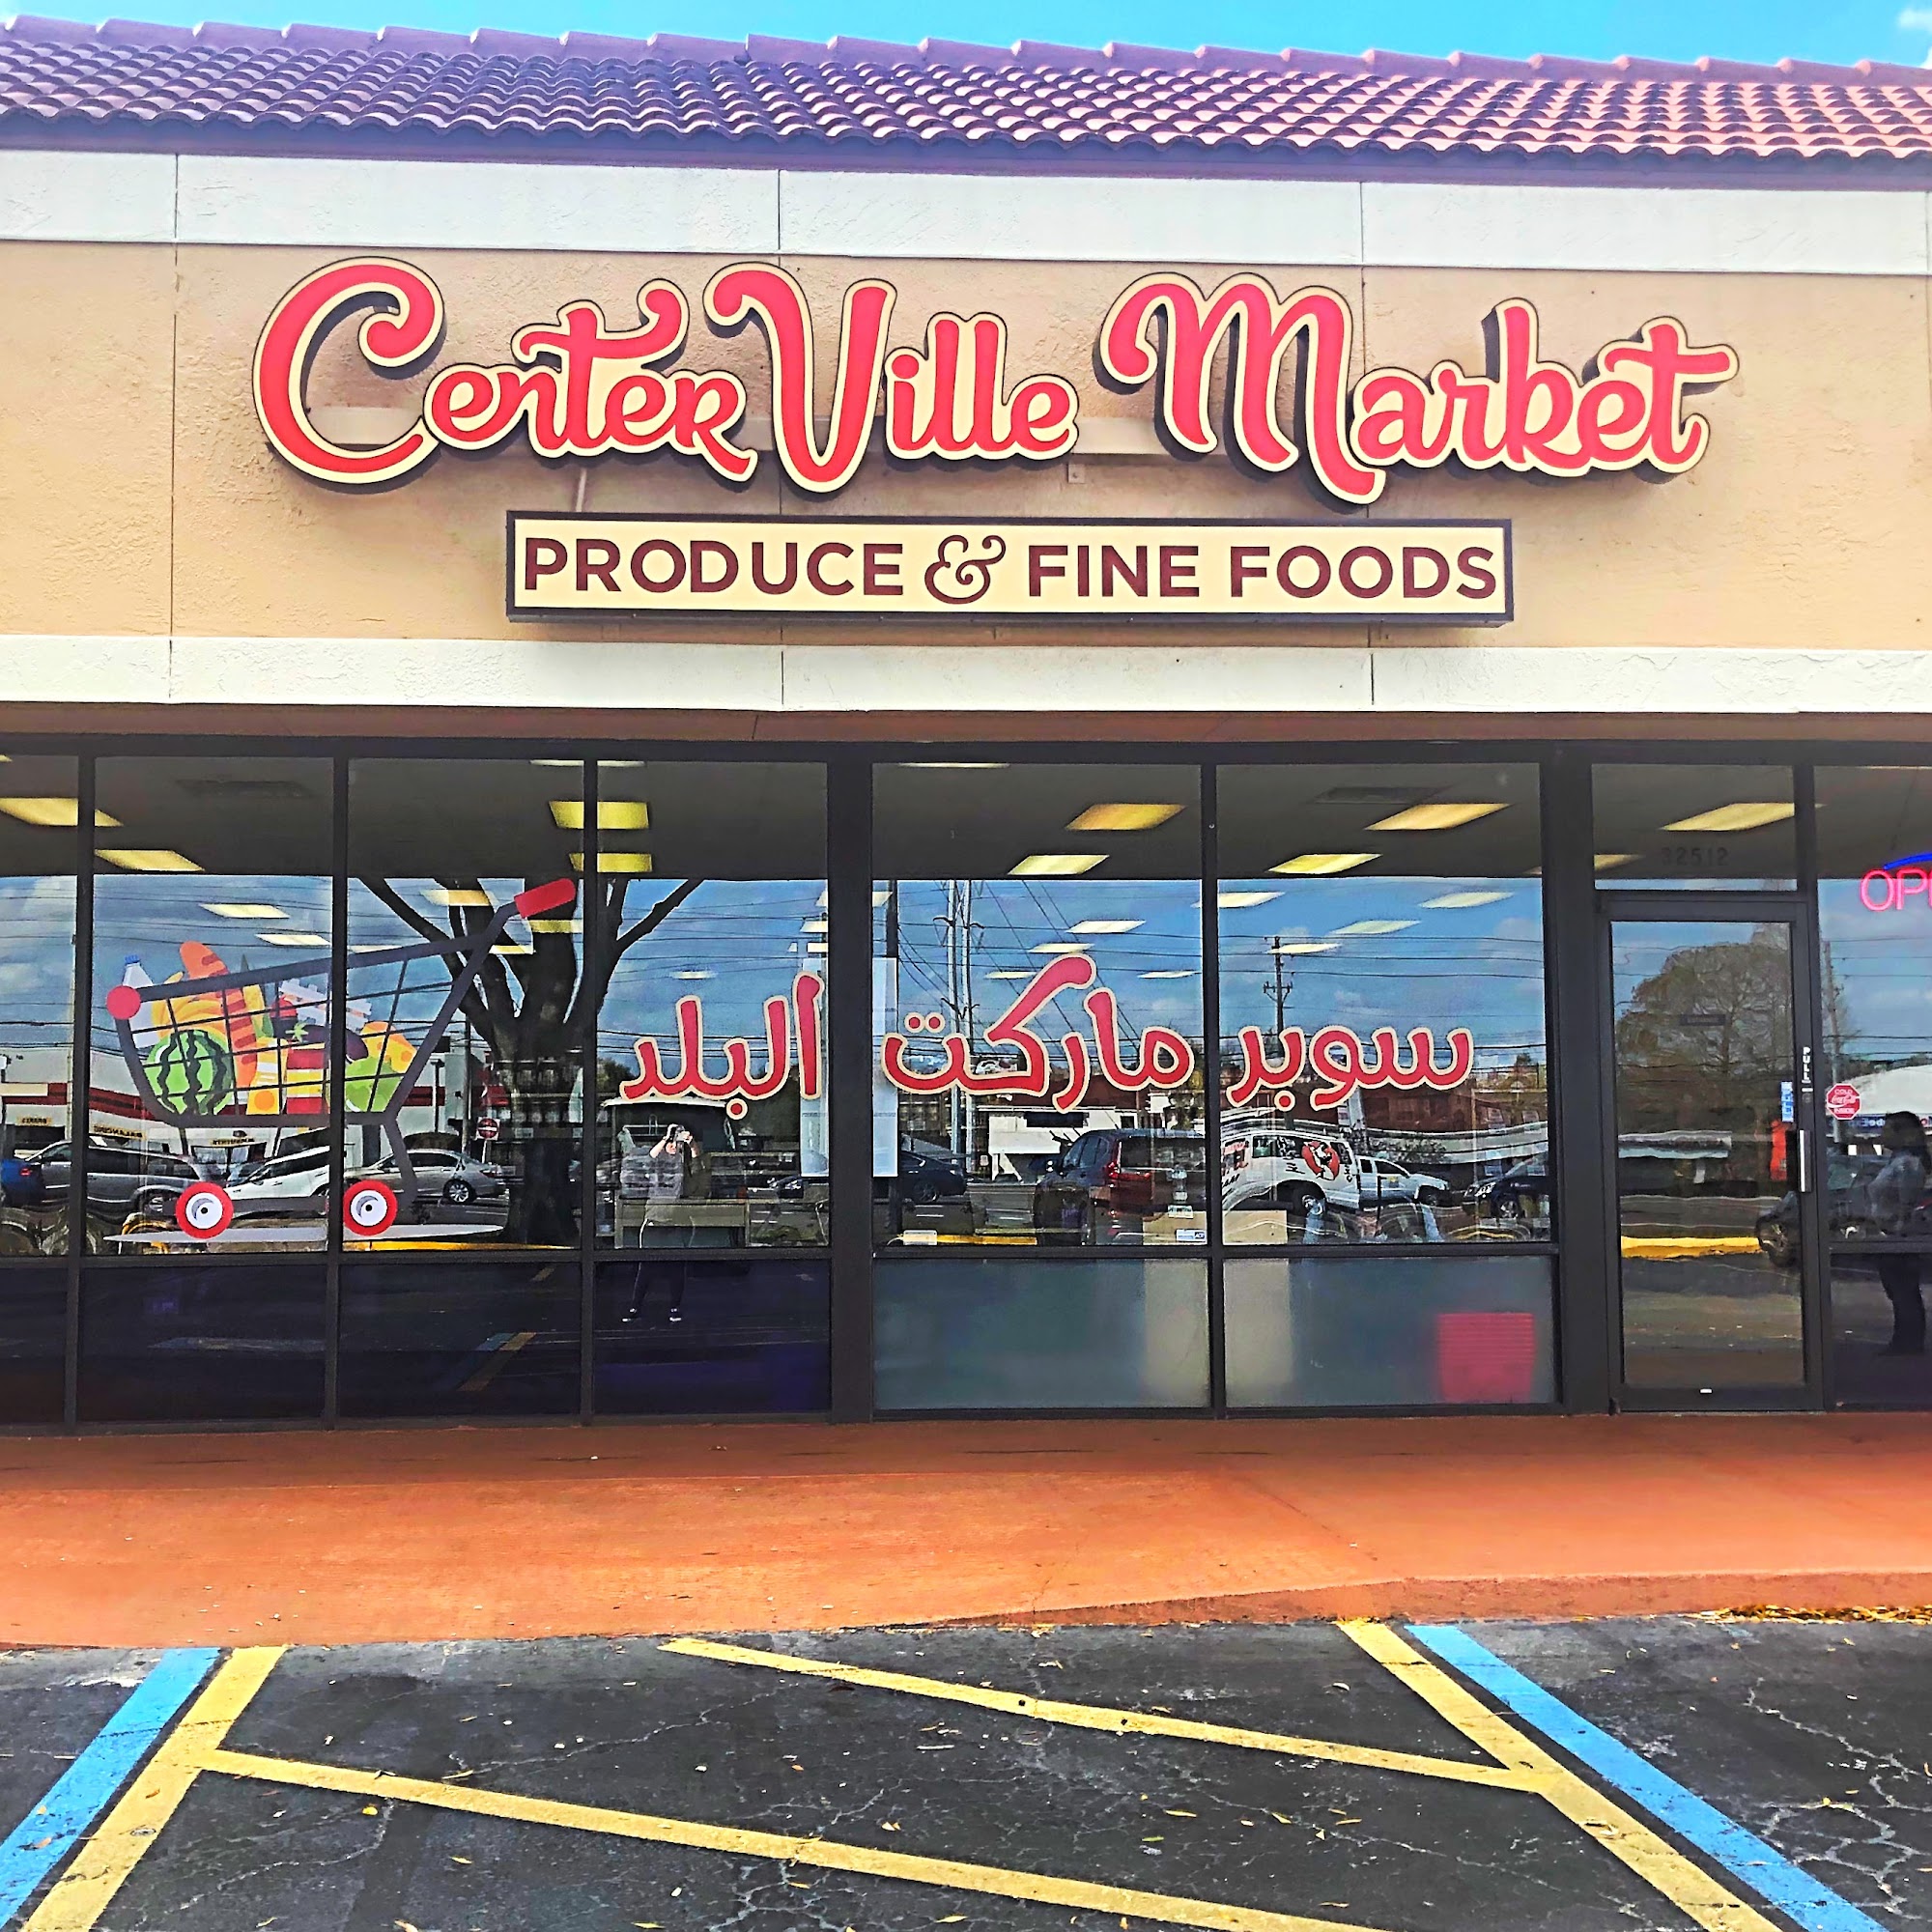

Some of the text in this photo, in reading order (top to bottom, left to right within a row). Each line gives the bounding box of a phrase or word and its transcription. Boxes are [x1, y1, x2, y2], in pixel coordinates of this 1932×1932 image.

[703, 263, 1078, 492] Ville
[1100, 273, 1738, 504] Market
[525, 534, 1497, 605] PRODUCE & FINE FOODS
[1860, 867, 1932, 912] OP
[619, 953, 1474, 1119] سوبر ماركت البلد
